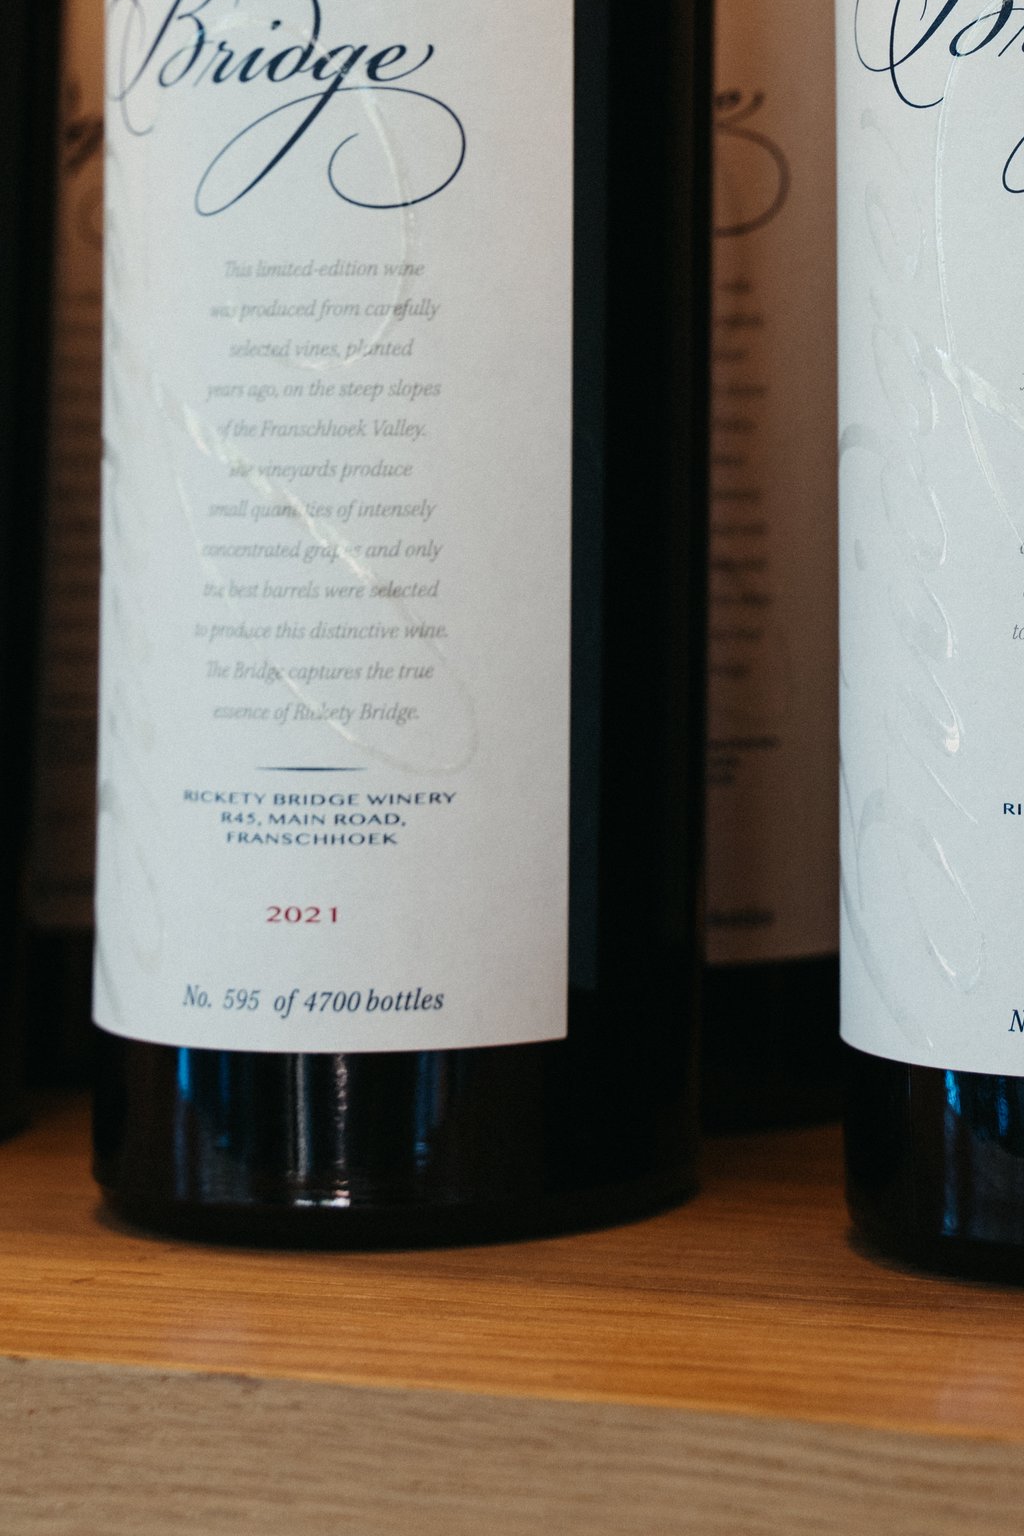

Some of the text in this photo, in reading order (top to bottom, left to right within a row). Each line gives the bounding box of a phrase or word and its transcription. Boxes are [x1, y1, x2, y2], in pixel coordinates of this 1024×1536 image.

[383, 262, 425, 276] wine
[238, 300, 317, 322] produced
[316, 300, 359, 322] from
[295, 340, 341, 358] vines,
[248, 384, 279, 401] ago,
[283, 384, 303, 397] on
[309, 379, 335, 396] the
[339, 383, 385, 401] steep
[388, 379, 441, 401] slopes
[260, 420, 368, 437] Franschhoek
[373, 420, 427, 441] Valley.
[257, 461, 338, 482] vineyards
[340, 460, 413, 482] produce
[336, 500, 355, 522] of
[357, 499, 437, 521] intensely
[365, 541, 401, 558] and
[405, 540, 444, 562] only
[263, 581, 320, 598] barrels
[325, 585, 364, 598] were
[369, 580, 440, 598] selected
[275, 622, 305, 639] this
[309, 621, 399, 639] distinctive
[404, 623, 448, 639] wine.
[288, 663, 362, 685] captures
[367, 662, 393, 679] the
[398, 663, 434, 679] true
[274, 703, 293, 725] of
[359, 703, 420, 725] Bridge.
[183, 790, 457, 806] RICKETY BRIDGE WINERY
[221, 811, 406, 827] R45, MAIN ROAD,
[227, 831, 398, 845] FRANSCHHOEK
[266, 905, 339, 924] 2021
[183, 984, 444, 1019] No. 595 of 4700 bottles
